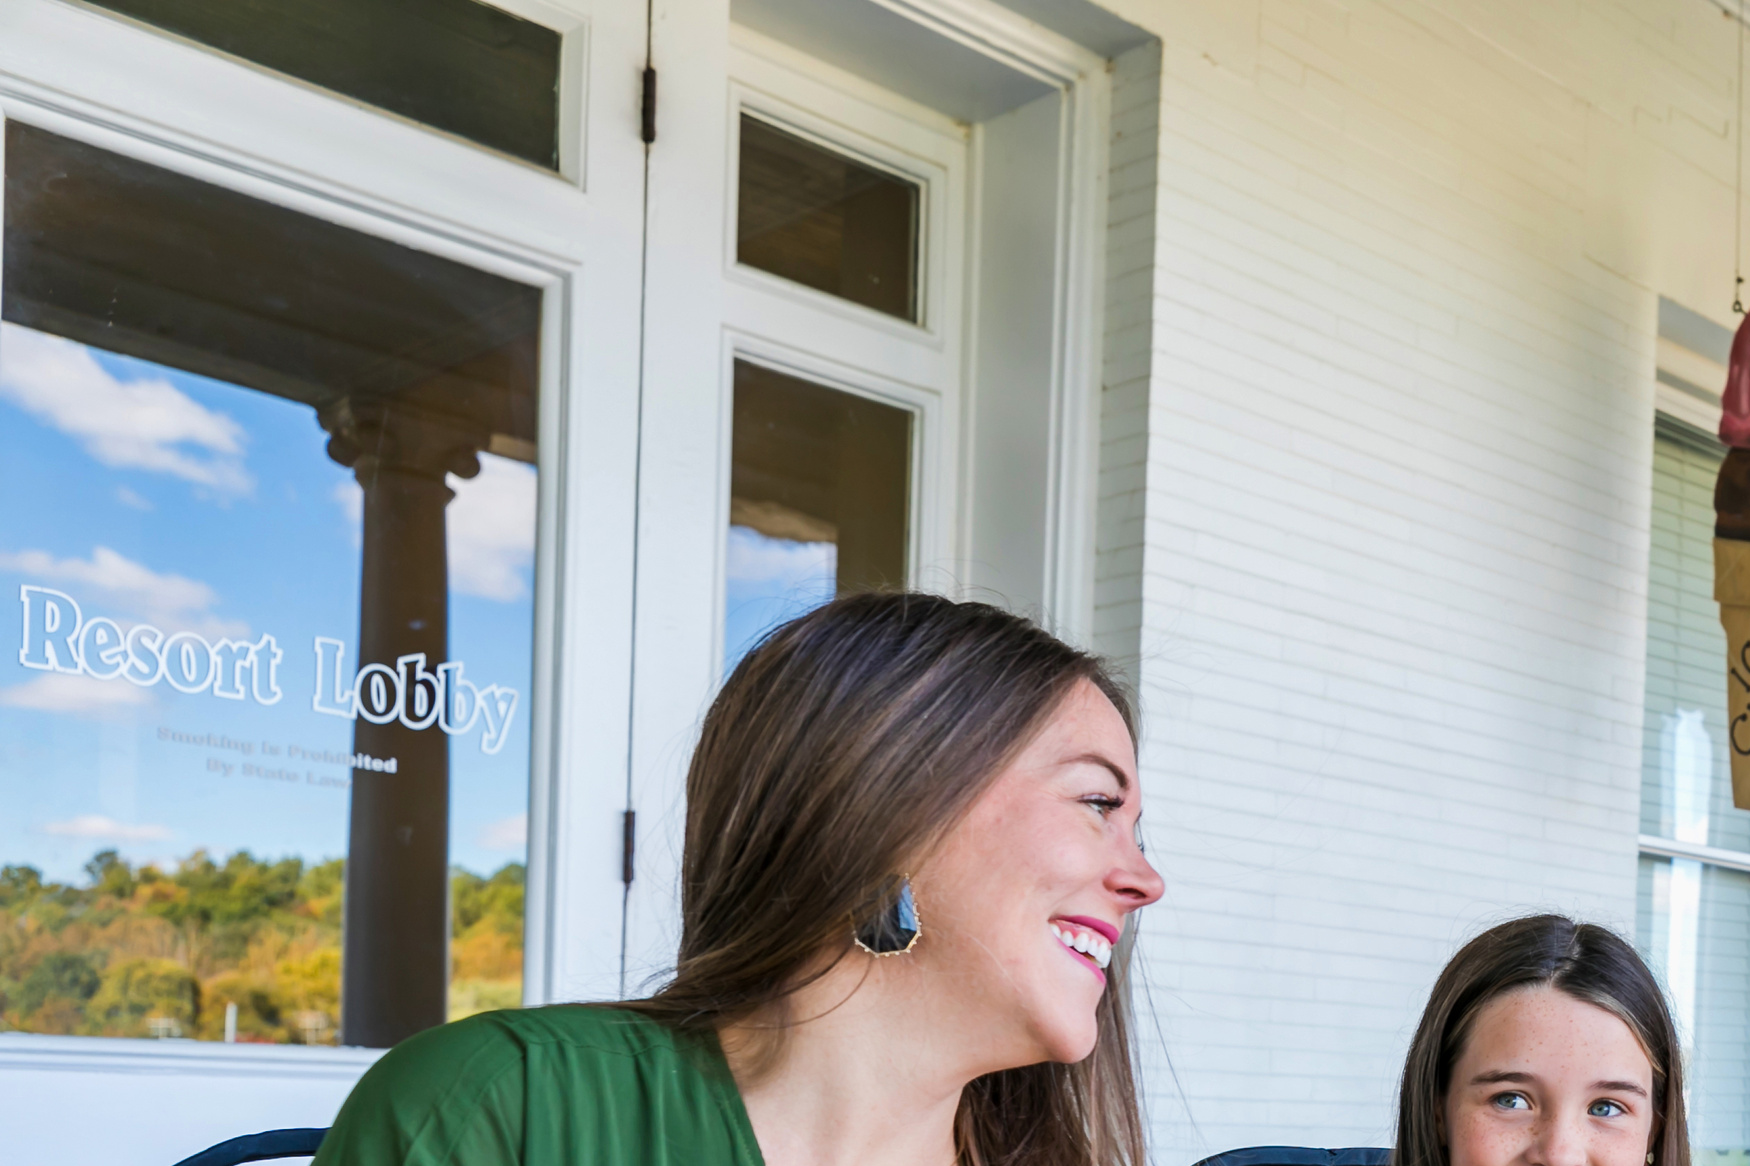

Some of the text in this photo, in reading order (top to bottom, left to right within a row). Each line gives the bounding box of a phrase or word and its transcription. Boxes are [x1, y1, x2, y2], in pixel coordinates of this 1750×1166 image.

[19, 584, 519, 754] Resort Lobby
[157, 726, 255, 756] Smoking
[288, 745, 398, 774] Prohibited
[206, 757, 351, 790] By State Law
